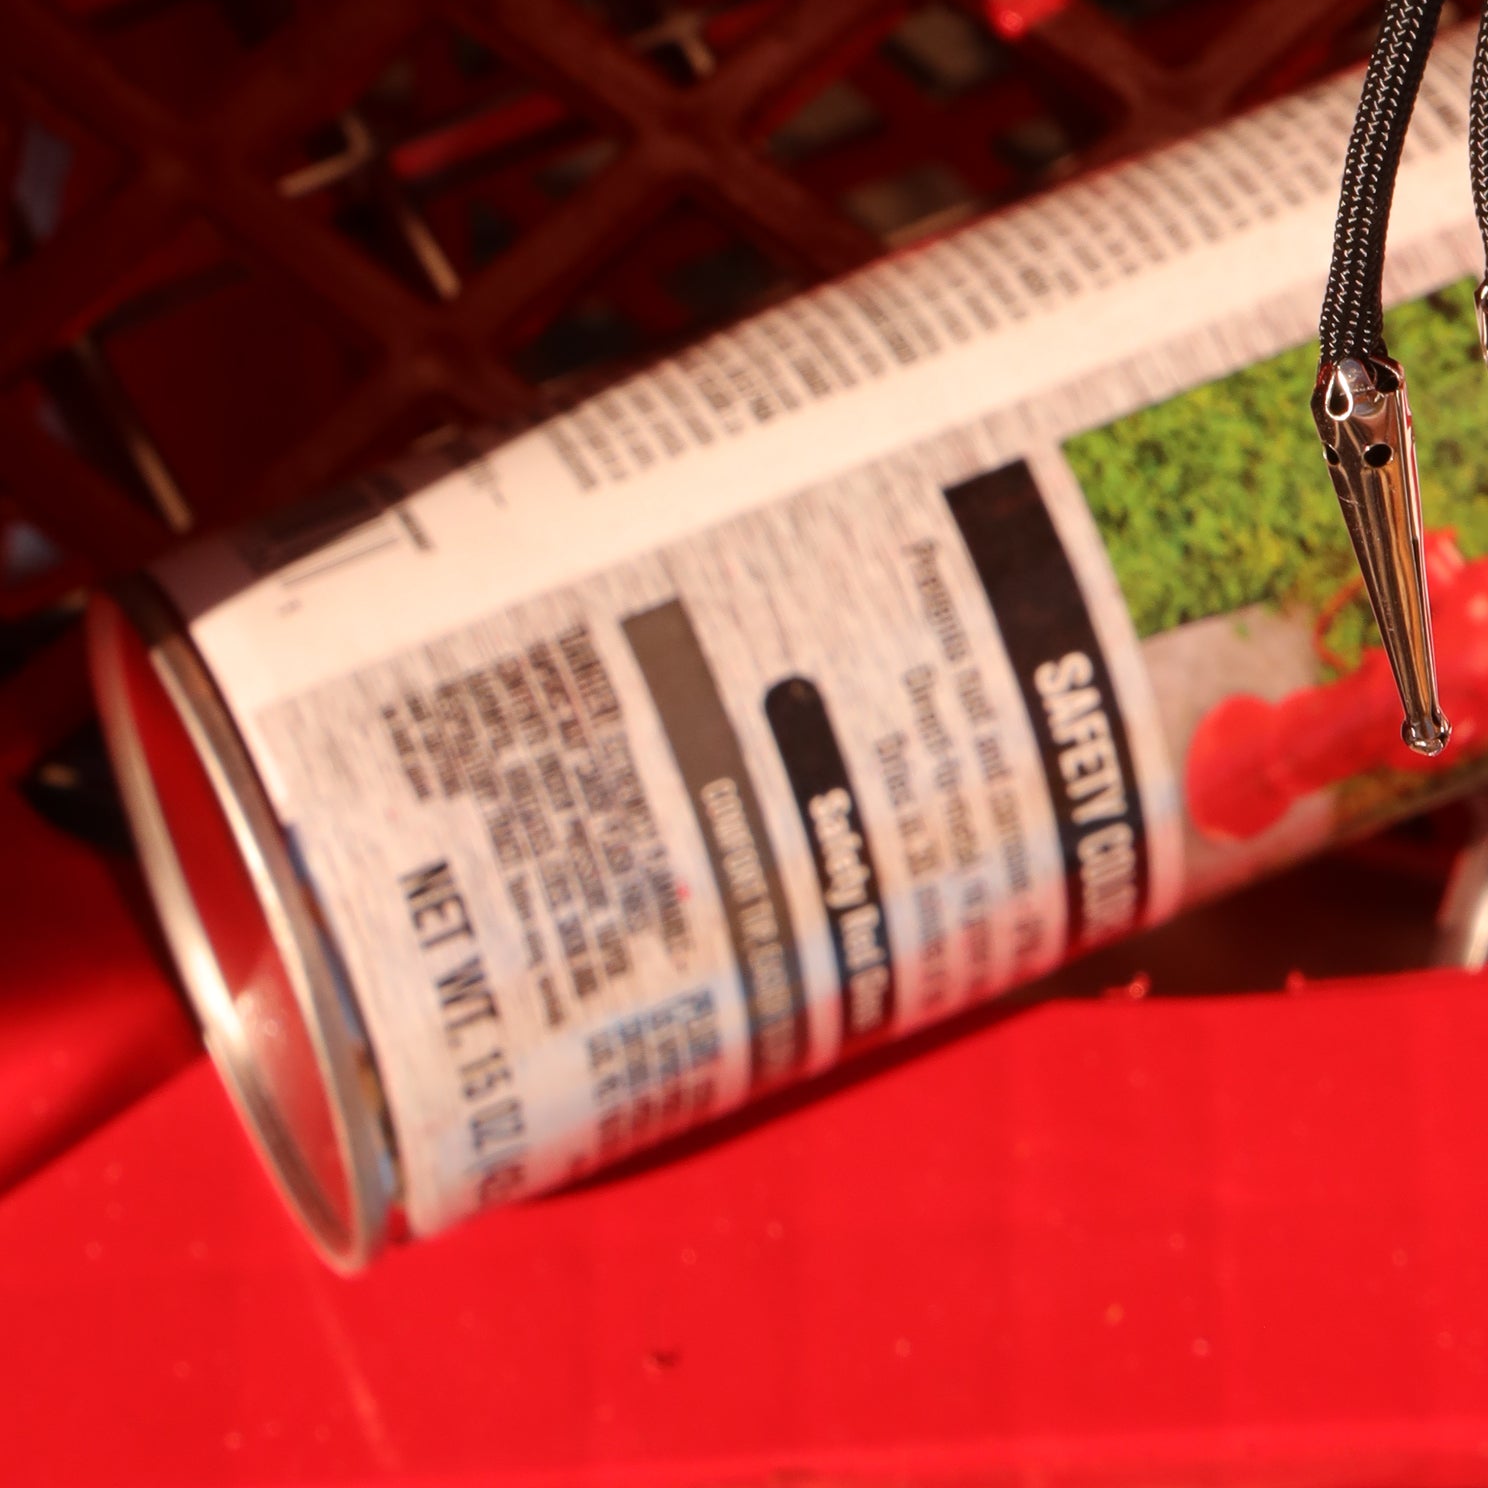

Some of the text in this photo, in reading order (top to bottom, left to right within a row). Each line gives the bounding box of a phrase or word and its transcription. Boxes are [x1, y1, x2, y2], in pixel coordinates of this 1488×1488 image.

[1034, 651, 1128, 823] SAFETY
[809, 787, 870, 910] Safety
[401, 860, 474, 949] NET
[437, 958, 499, 1049] WT.
[460, 1051, 512, 1101] 15
